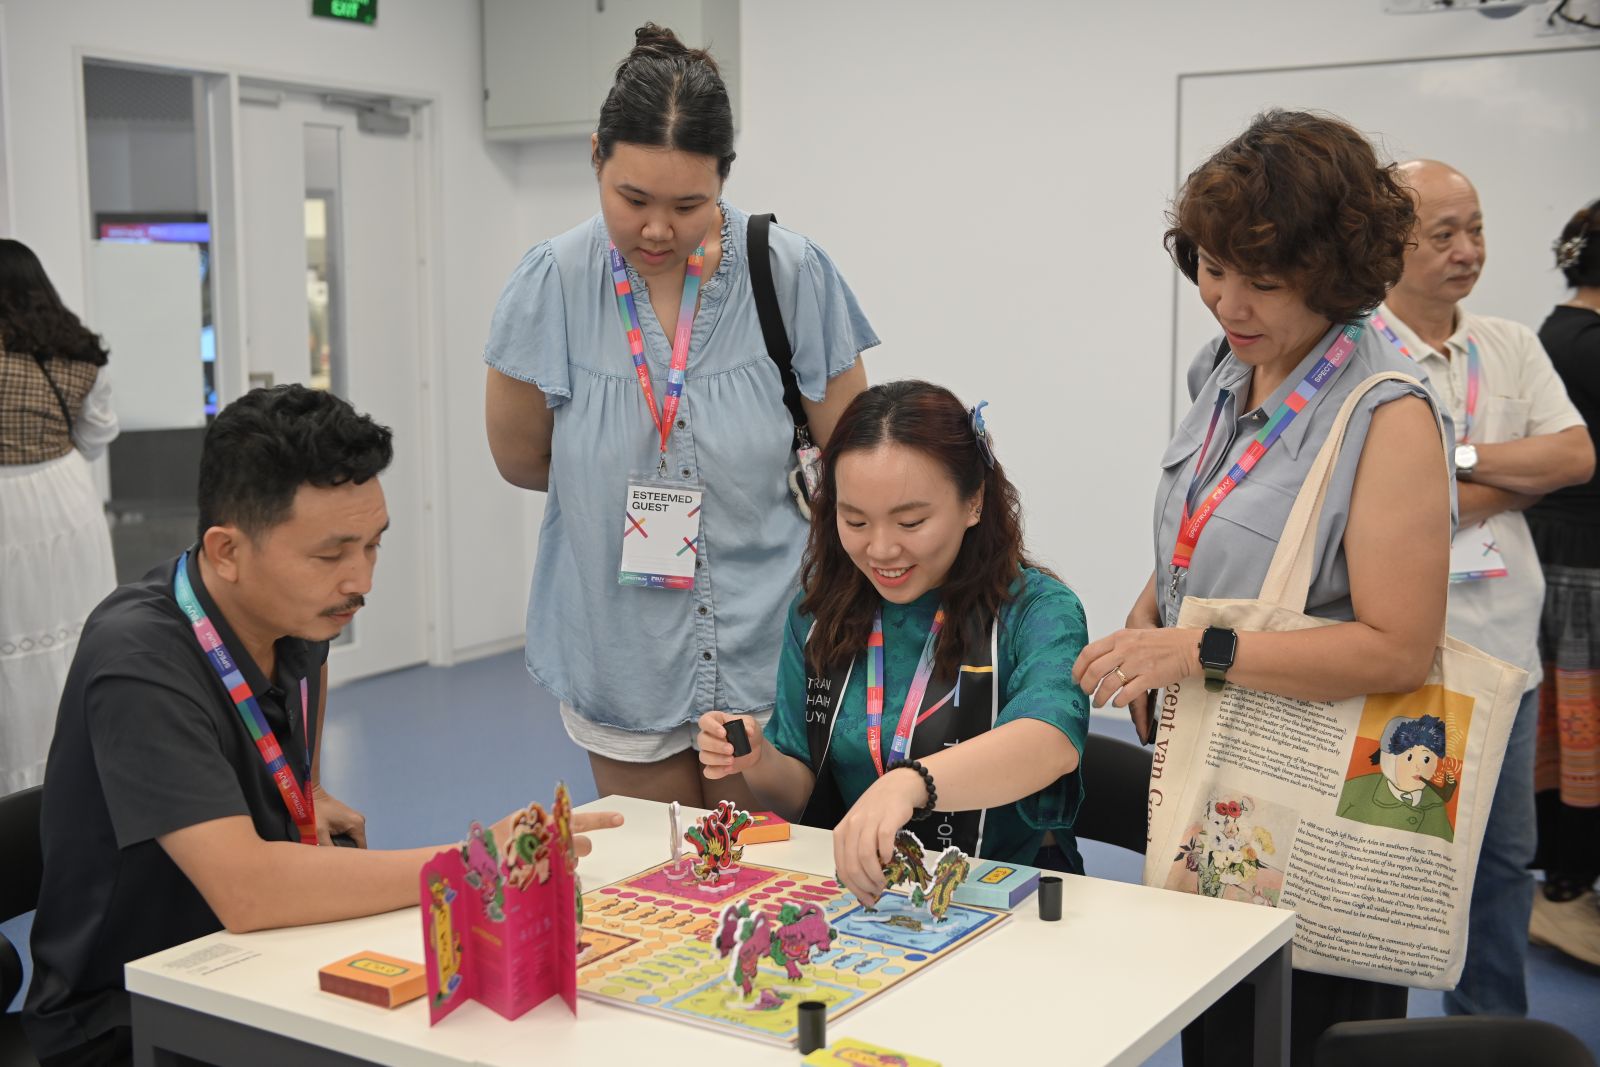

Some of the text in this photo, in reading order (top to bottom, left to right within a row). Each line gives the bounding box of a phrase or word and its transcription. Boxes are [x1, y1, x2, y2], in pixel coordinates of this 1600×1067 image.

[1314, 348, 1345, 383] SPECTRUM
[667, 390, 677, 423] SPECTRUM
[632, 490, 693, 504] ESTEEMED
[631, 501, 669, 512] GUEST
[1188, 505, 1211, 539] SPECTRUM
[206, 631, 232, 669] SPECTRUM
[1159, 682, 1181, 732] cent
[1151, 739, 1169, 779] van
[1266, 747, 1279, 755] know
[1280, 753, 1292, 761] many
[1262, 761, 1280, 772] Through
[1325, 827, 1338, 836] Gogh
[1300, 847, 1312, 856] began
[1355, 864, 1369, 872] brush
[1376, 887, 1399, 896] Bedroom
[1284, 890, 1301, 899] painted
[1366, 914, 1389, 922] endowed
[1352, 901, 1365, 909] Gogh
[1328, 925, 1341, 933] Gogh
[1382, 954, 1393, 962] they
[1394, 957, 1409, 965] began
